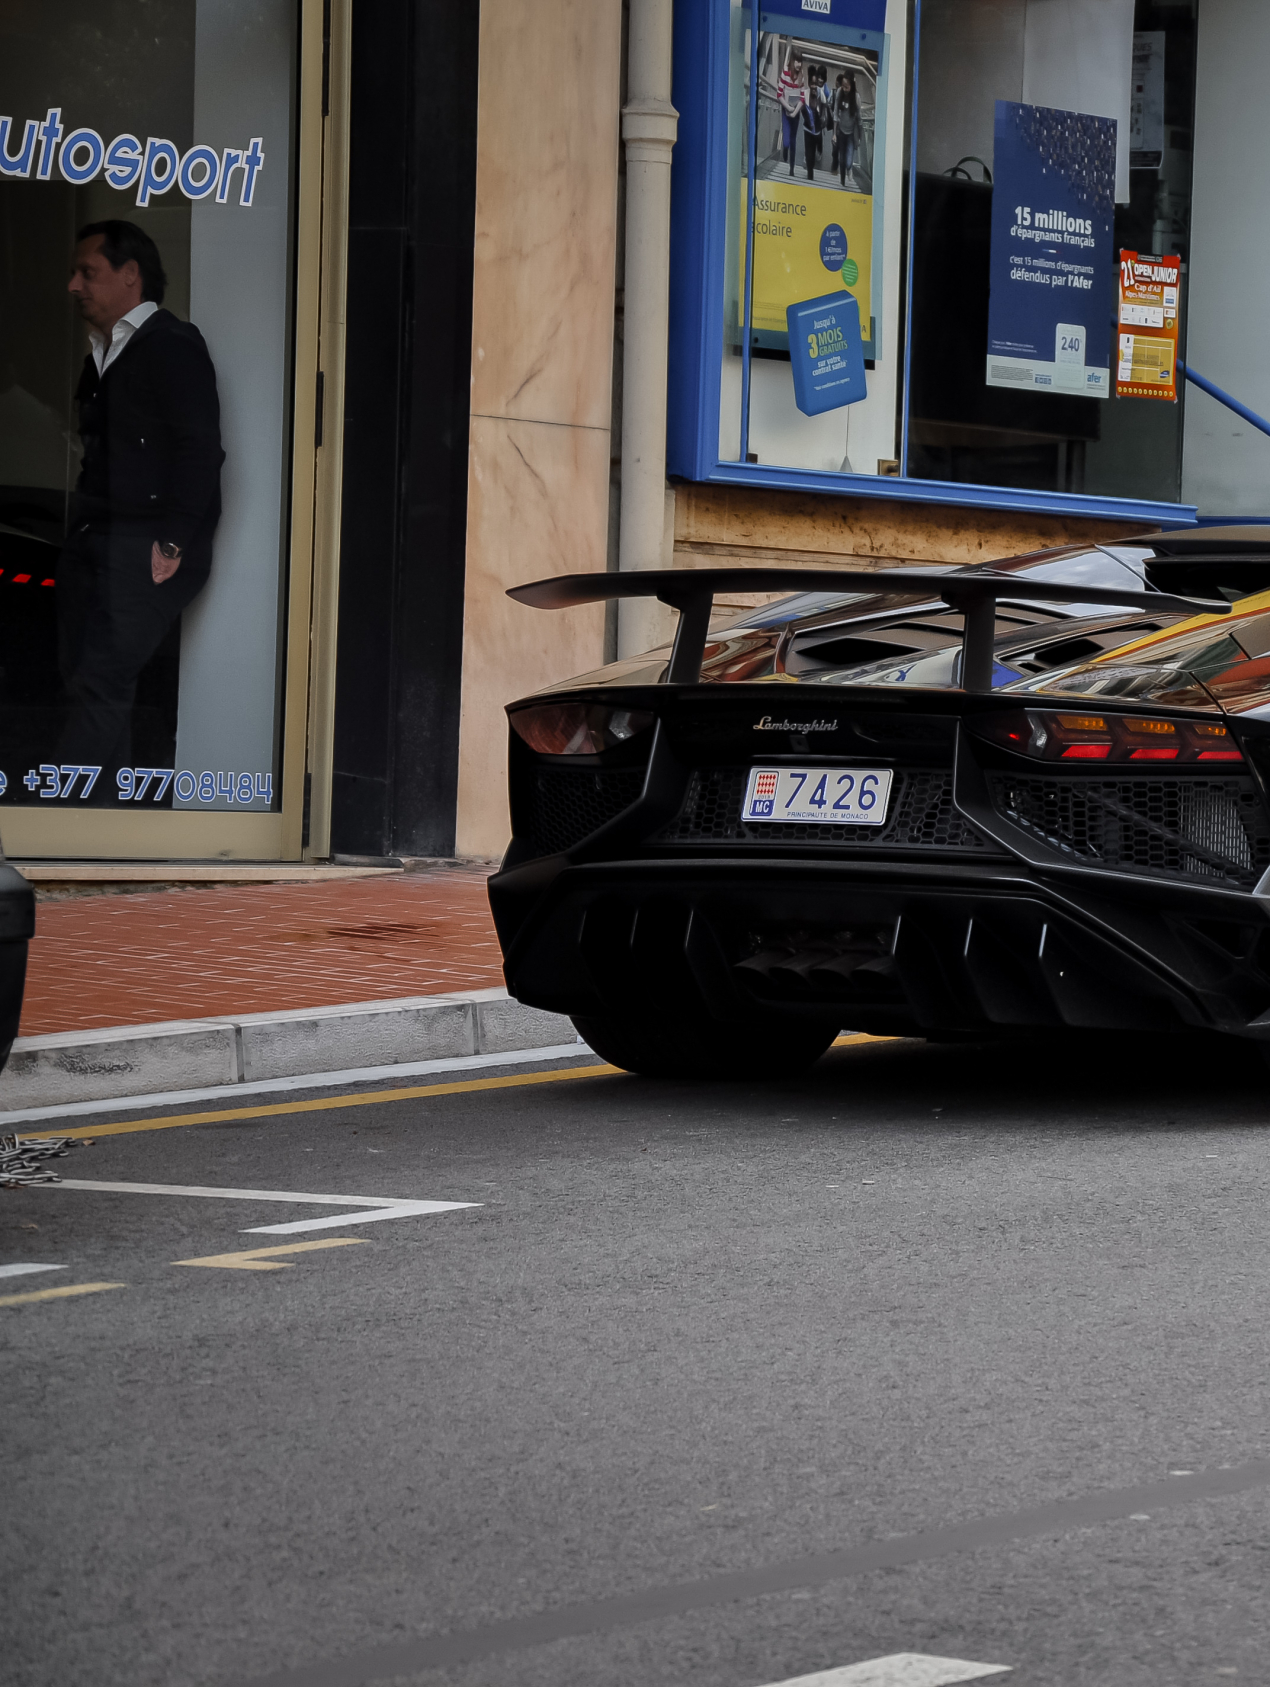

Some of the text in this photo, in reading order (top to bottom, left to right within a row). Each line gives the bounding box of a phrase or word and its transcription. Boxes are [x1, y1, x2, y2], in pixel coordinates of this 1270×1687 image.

[803, 0, 828, 12] AVIVA
[752, 220, 792, 238] colaire
[1015, 206, 1092, 234] 15 millions
[1010, 225, 1095, 248] d'épargnants français
[1010, 256, 1094, 274] c'est 15 millions d'épargnants
[1134, 264, 1152, 276] OPEN
[1152, 266, 1178, 284] JUNIOR
[1010, 267, 1092, 289] défendus par l'Afer
[1134, 283, 1146, 292] Cap
[808, 327, 843, 359] 3 MOIS
[819, 340, 848, 356] GRATUITS
[812, 364, 832, 376] contrat
[818, 356, 841, 368] sur votre
[1087, 372, 1102, 383] afer
[753, 716, 838, 734] Lamborghini
[24, 764, 102, 798] +377
[116, 768, 273, 804] 97708484
[784, 772, 880, 811] 7426
[756, 800, 770, 813] MC
